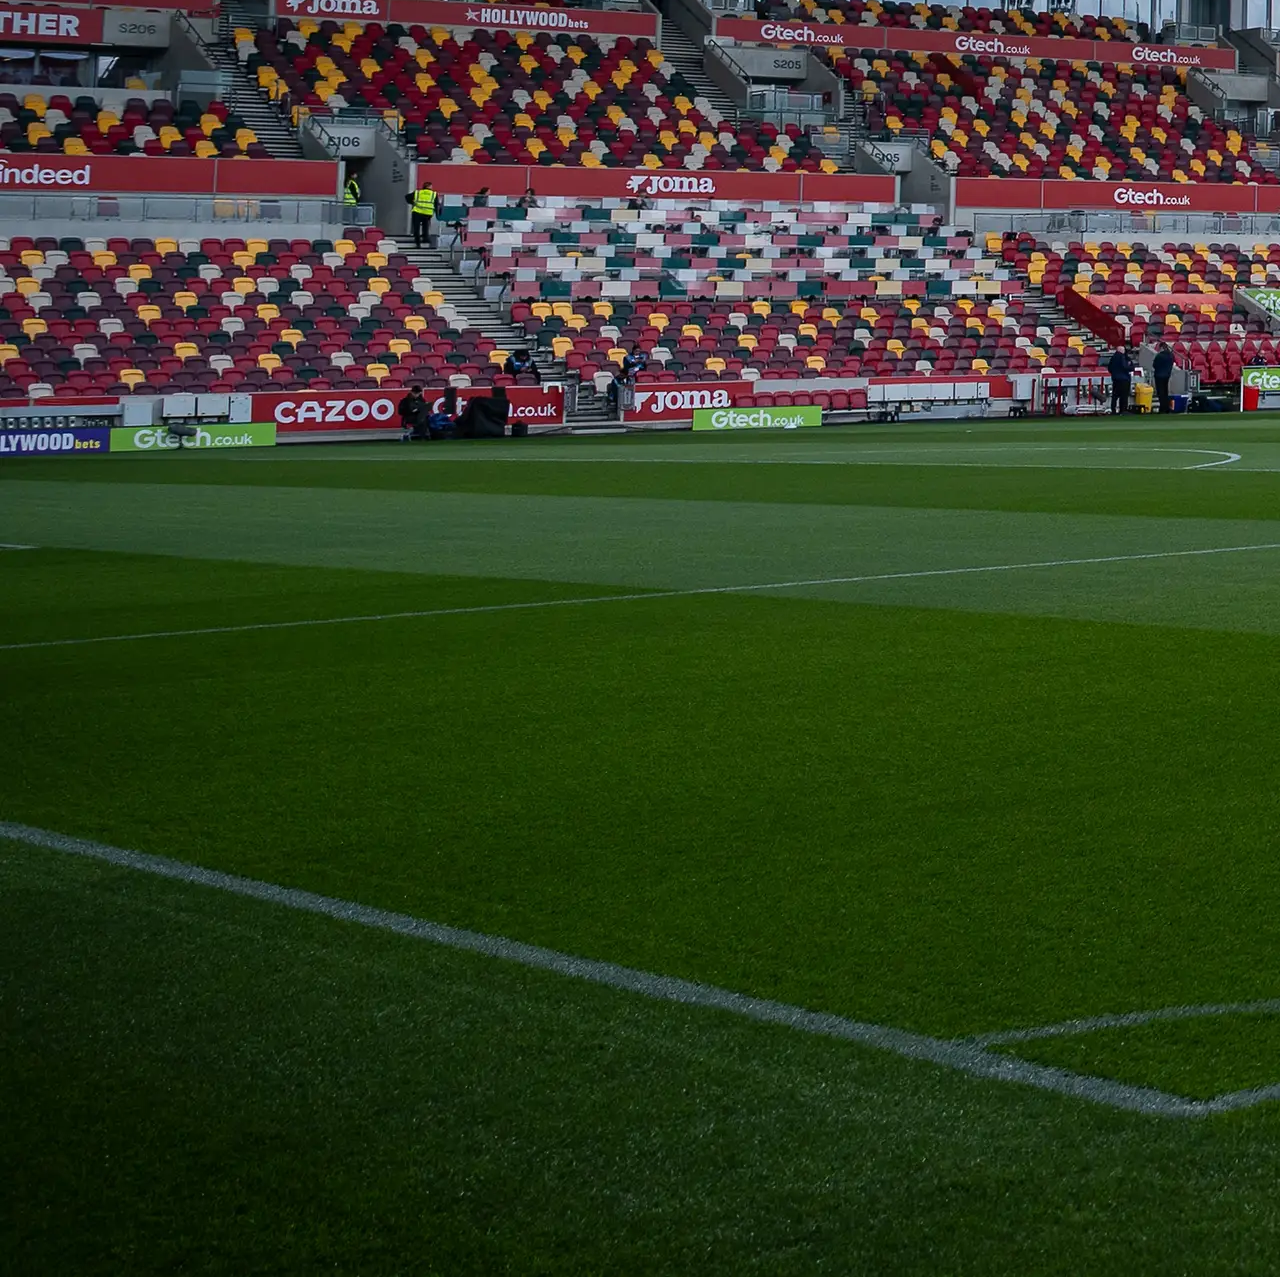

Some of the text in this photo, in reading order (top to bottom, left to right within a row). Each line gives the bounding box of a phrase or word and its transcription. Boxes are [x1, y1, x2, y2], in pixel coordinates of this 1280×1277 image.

[118, 23, 157, 34] S206
[761, 23, 843, 45] Gtech.co.uk
[955, 35, 1030, 56] Gtech.co.uk
[1132, 46, 1201, 65] Gtech.co.uk
[773, 58, 801, 71] S205
[1114, 187, 1190, 206] Gtech.co.uk
[274, 398, 395, 424] CAZOO
[711, 409, 804, 430] Gtech.co.uk
